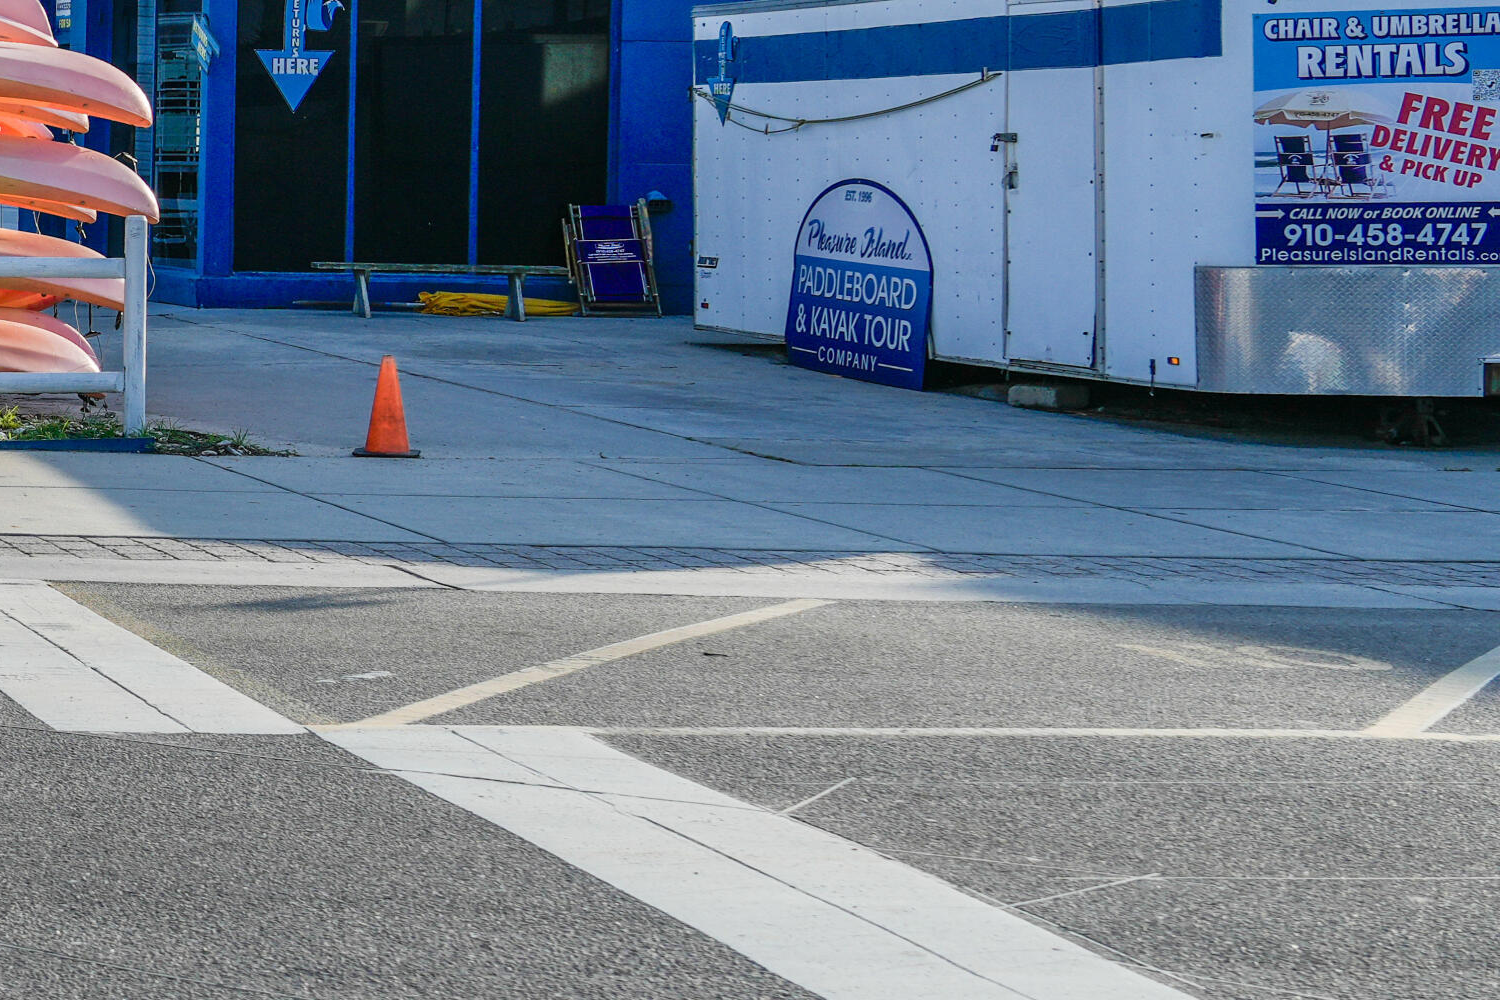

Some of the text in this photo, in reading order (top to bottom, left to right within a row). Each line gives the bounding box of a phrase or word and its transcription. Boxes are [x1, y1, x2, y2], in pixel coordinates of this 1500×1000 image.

[1264, 17, 1340, 41] CHAIR
[1345, 16, 1368, 40] &
[272, 58, 319, 76] HERE
[1296, 42, 1469, 79] RENTALS
[714, 83, 732, 95] HERE
[1396, 92, 1497, 141] FREE
[1369, 124, 1500, 171] DELIVERY
[1379, 155, 1483, 188] & PICK UP
[1289, 206, 1482, 220] CALL NOW or BOOK ONLINE
[808, 218, 911, 261] Pleasure Island
[1284, 222, 1487, 246] 910-458-4747
[1262, 247, 1500, 262] PleasureIslandRentals.co
[798, 264, 917, 310] PADDLEBOARD
[795, 304, 912, 352] & KAYAK TOUR
[818, 345, 878, 372] COMPANY
